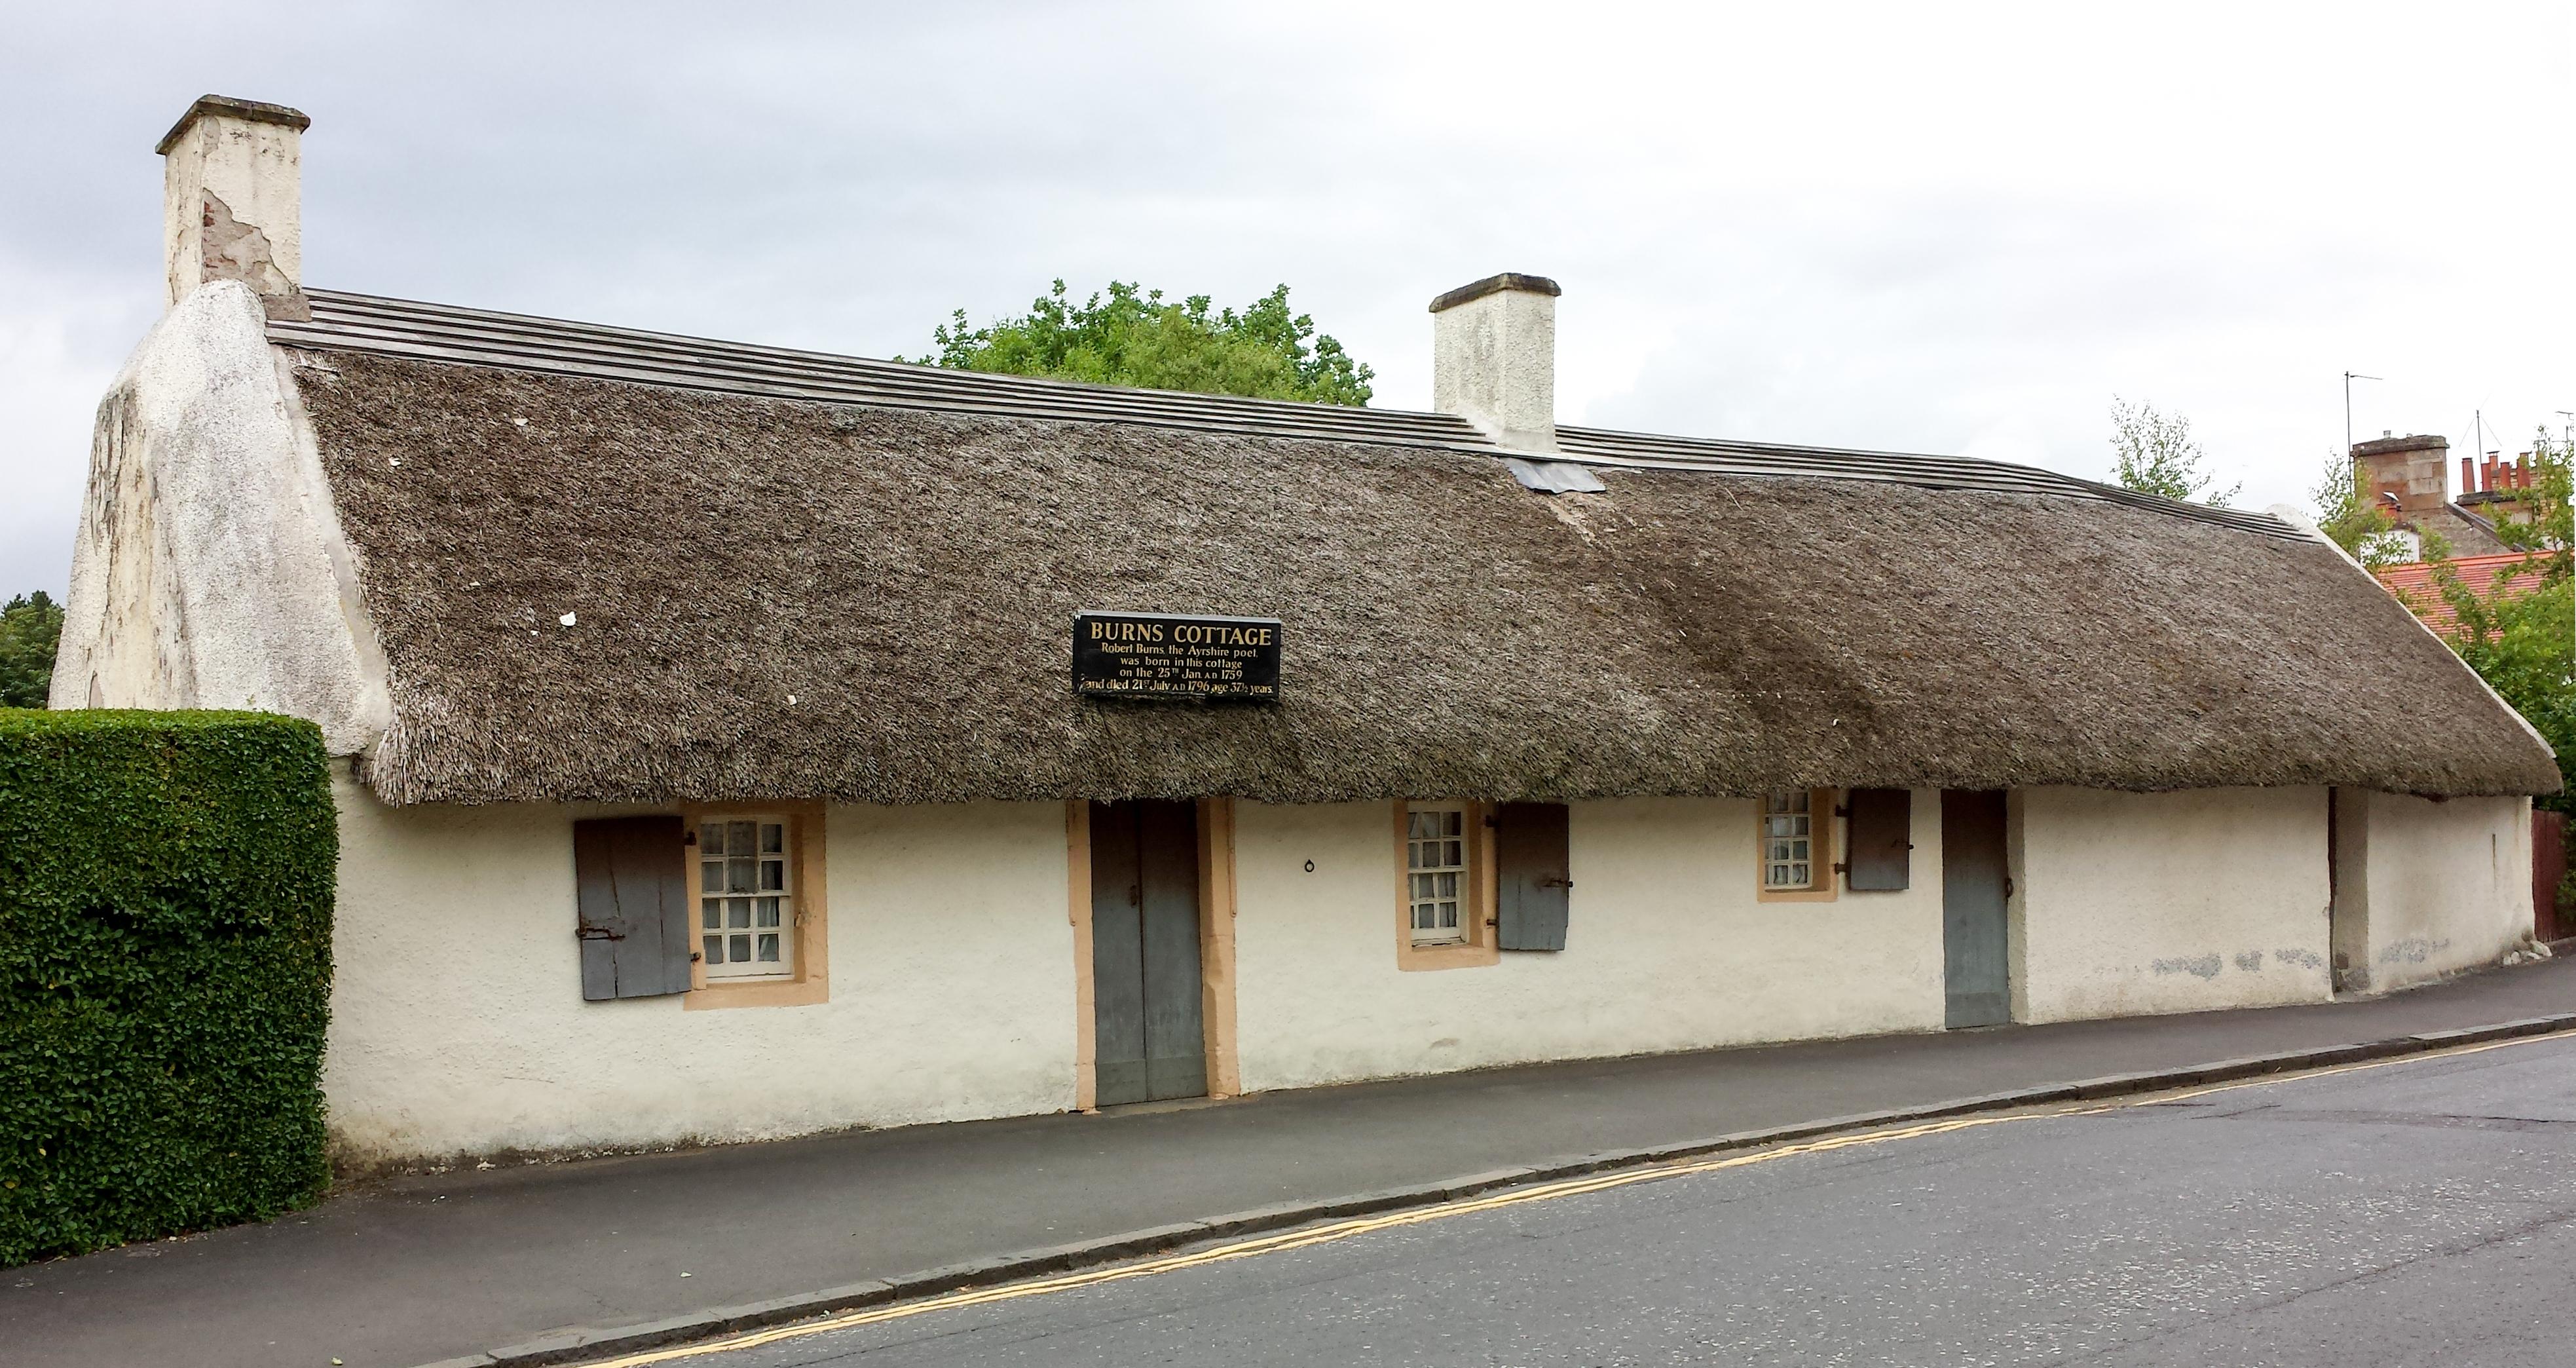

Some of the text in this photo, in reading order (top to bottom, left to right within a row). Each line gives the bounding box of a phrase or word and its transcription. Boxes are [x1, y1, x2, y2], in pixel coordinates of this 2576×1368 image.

[1091, 622, 1271, 645] BURNS COTTAGE
[1102, 642, 1133, 654] Robert
[1168, 645, 1184, 655] the
[1187, 645, 1229, 657] Ayrshire
[1145, 656, 1170, 666] born
[1174, 657, 1184, 666] in
[1187, 658, 1203, 667] this
[1206, 659, 1242, 670] cottage
[1136, 668, 1153, 677] the
[1222, 670, 1242, 680] 1759
[1086, 679, 1104, 689] and
[1106, 679, 1129, 690] died
[1149, 680, 1171, 691] July
[1188, 681, 1210, 692] 1796
[1211, 684, 1229, 694] age
